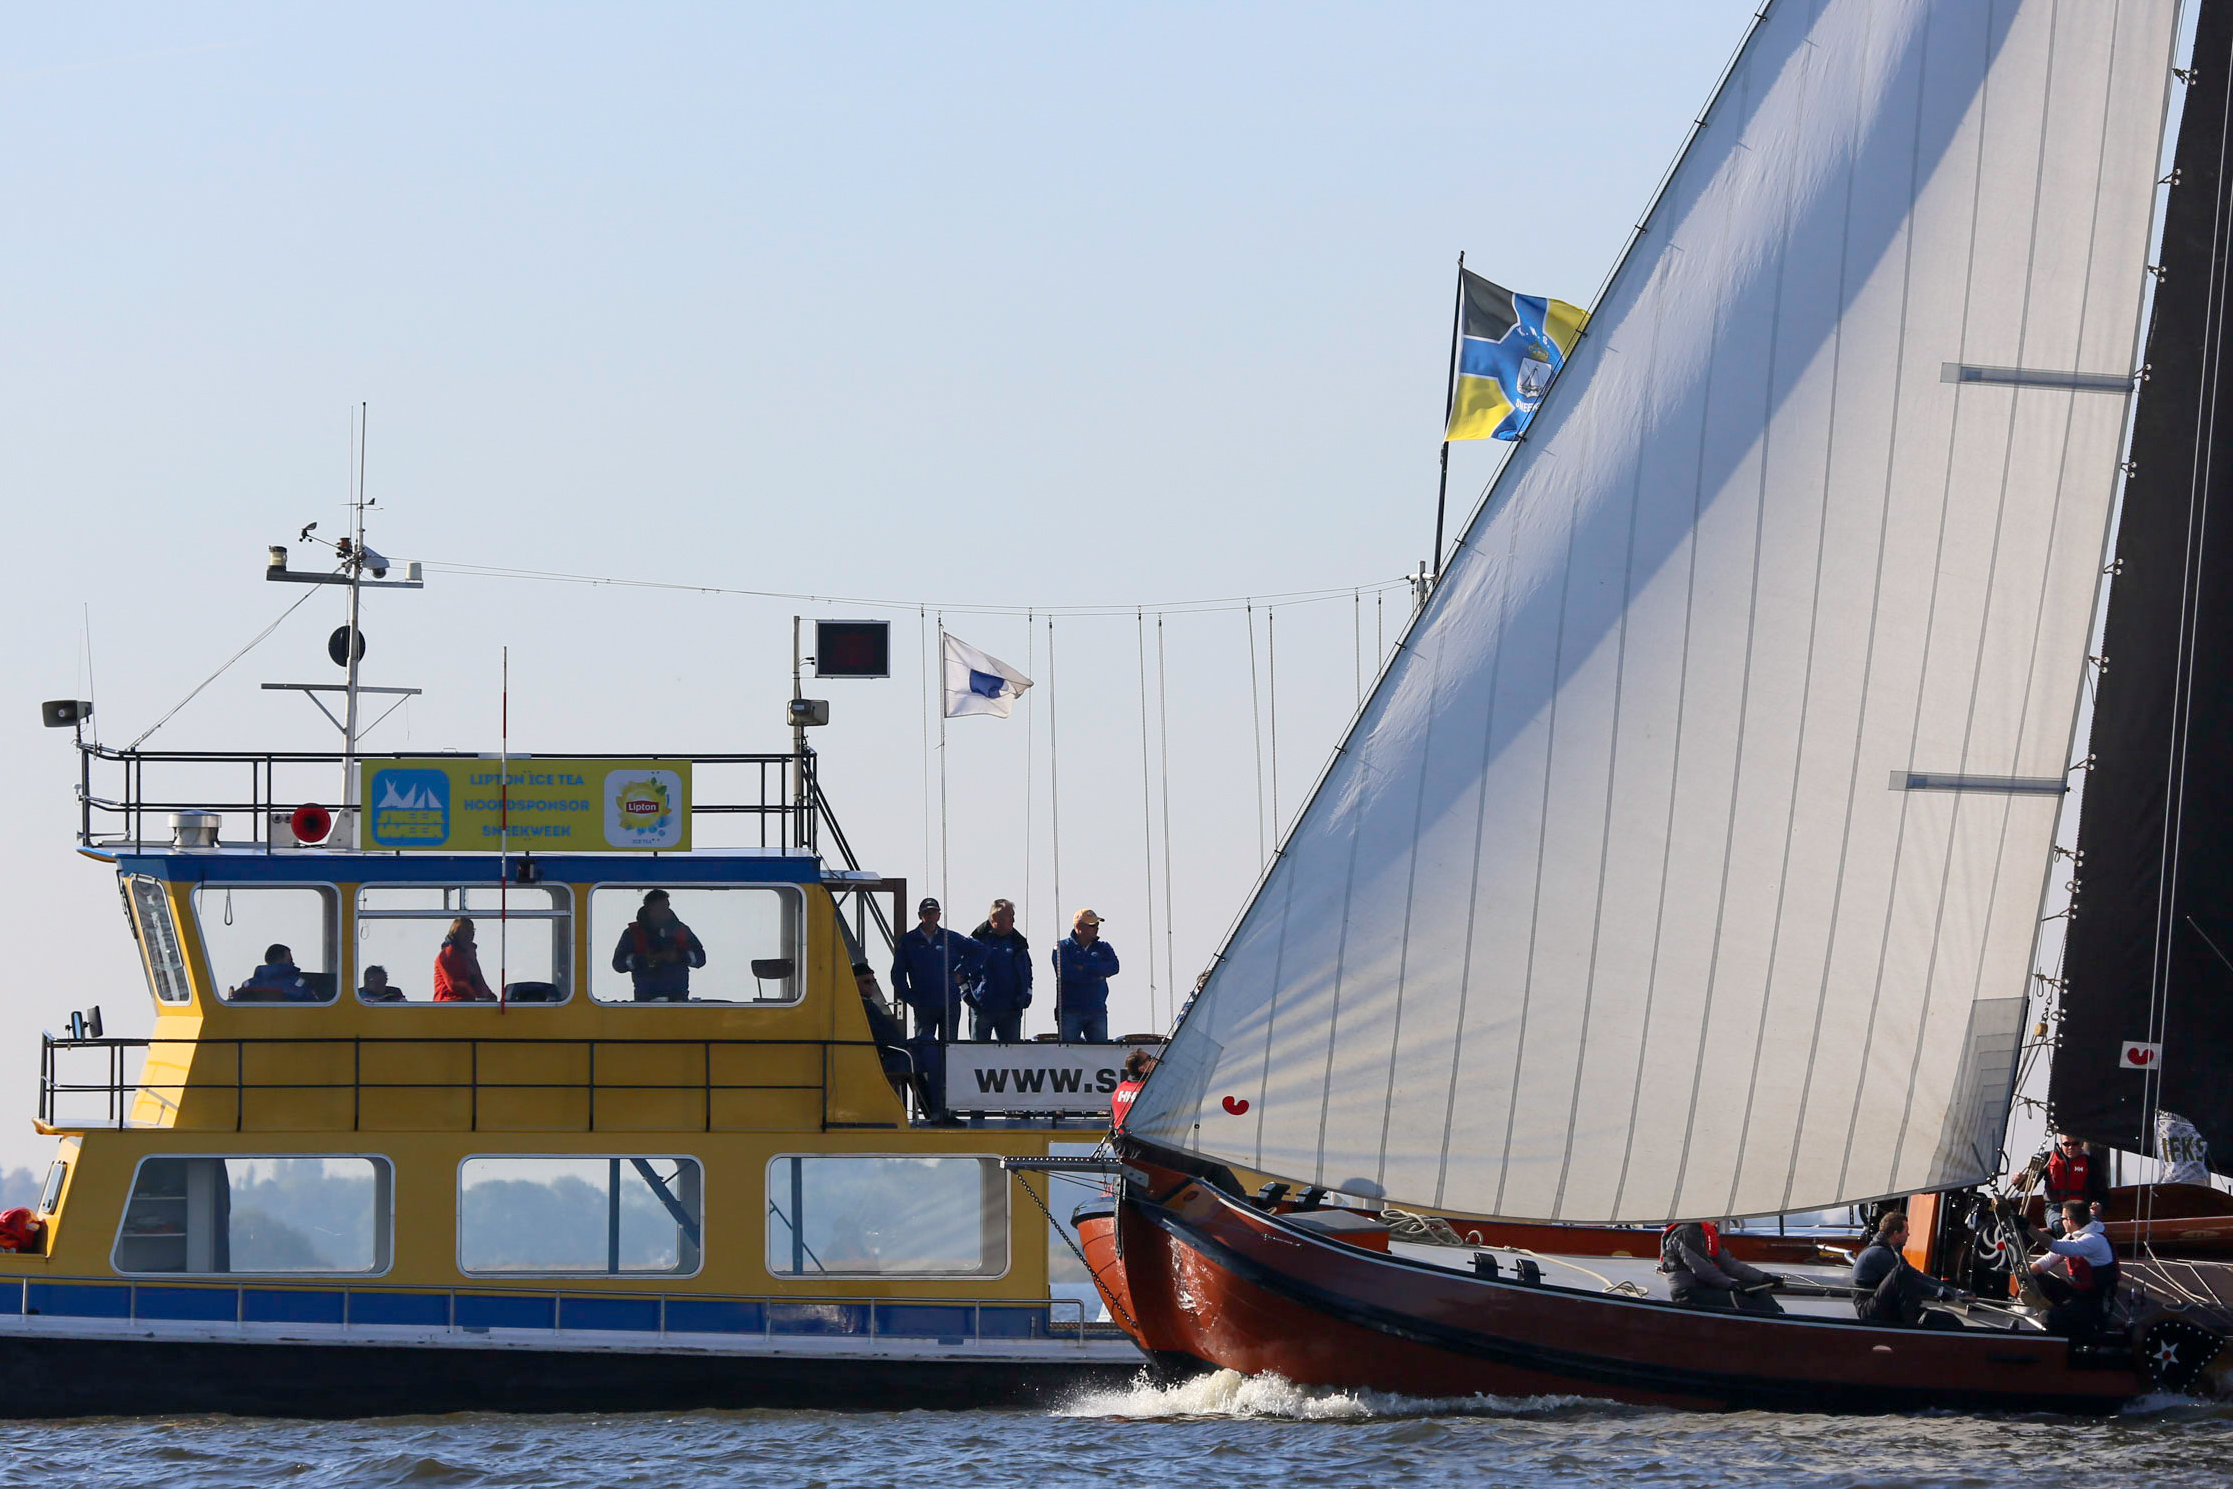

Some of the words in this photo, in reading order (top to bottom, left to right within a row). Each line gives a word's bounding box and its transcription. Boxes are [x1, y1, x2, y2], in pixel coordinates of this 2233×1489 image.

[470, 774, 524, 786] LIPTON
[529, 774, 553, 786] ICE
[558, 774, 585, 786] TEA
[628, 803, 657, 813] Lipton
[481, 825, 571, 837] SNEEKWEEK
